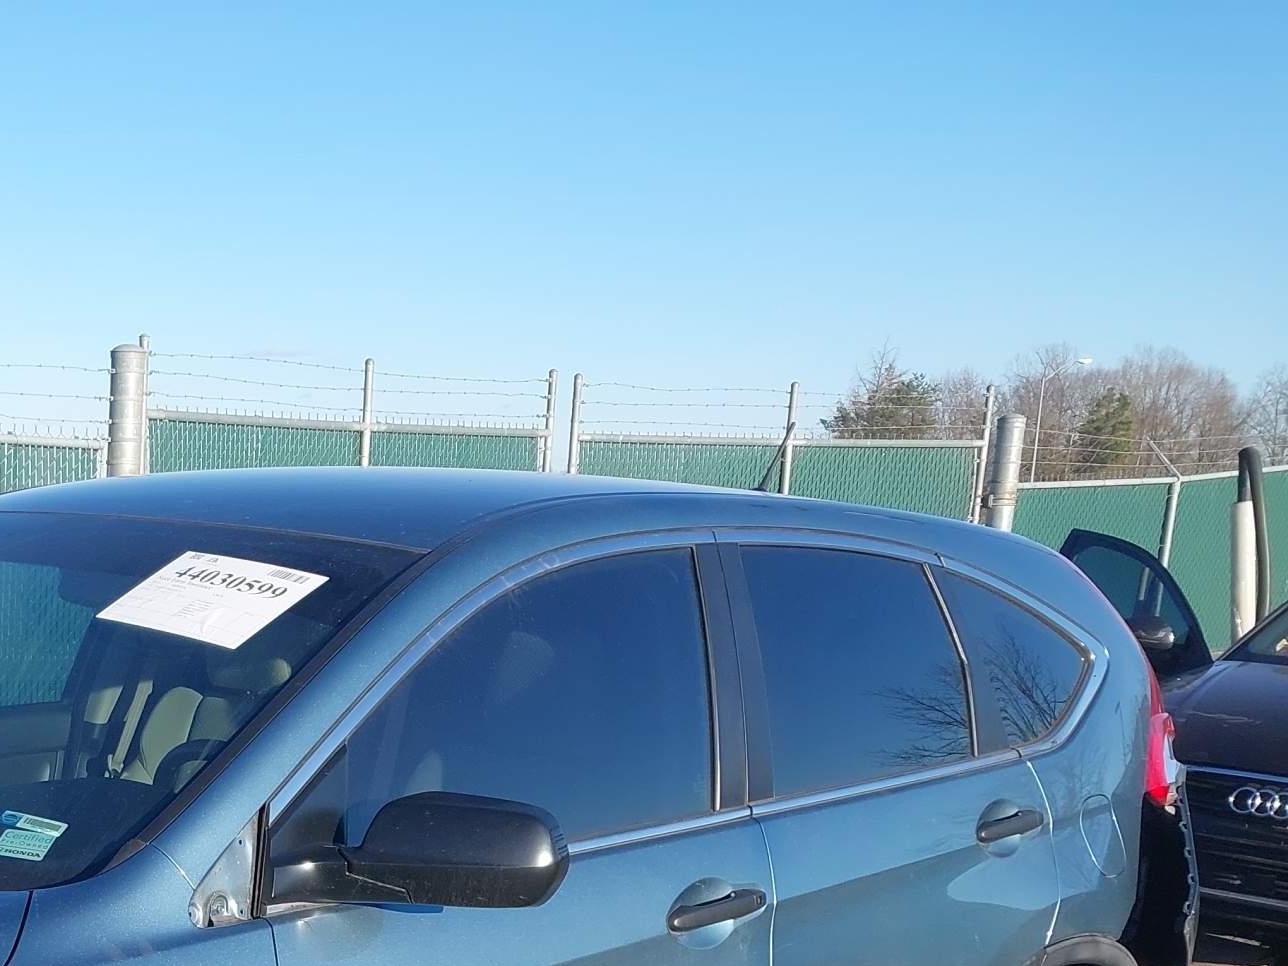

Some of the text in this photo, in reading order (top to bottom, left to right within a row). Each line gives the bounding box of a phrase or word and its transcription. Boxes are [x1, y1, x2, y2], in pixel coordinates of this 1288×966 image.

[175, 566, 289, 599] 44030599
[5, 831, 52, 844] Certified
[3, 847, 41, 858] HONDA
